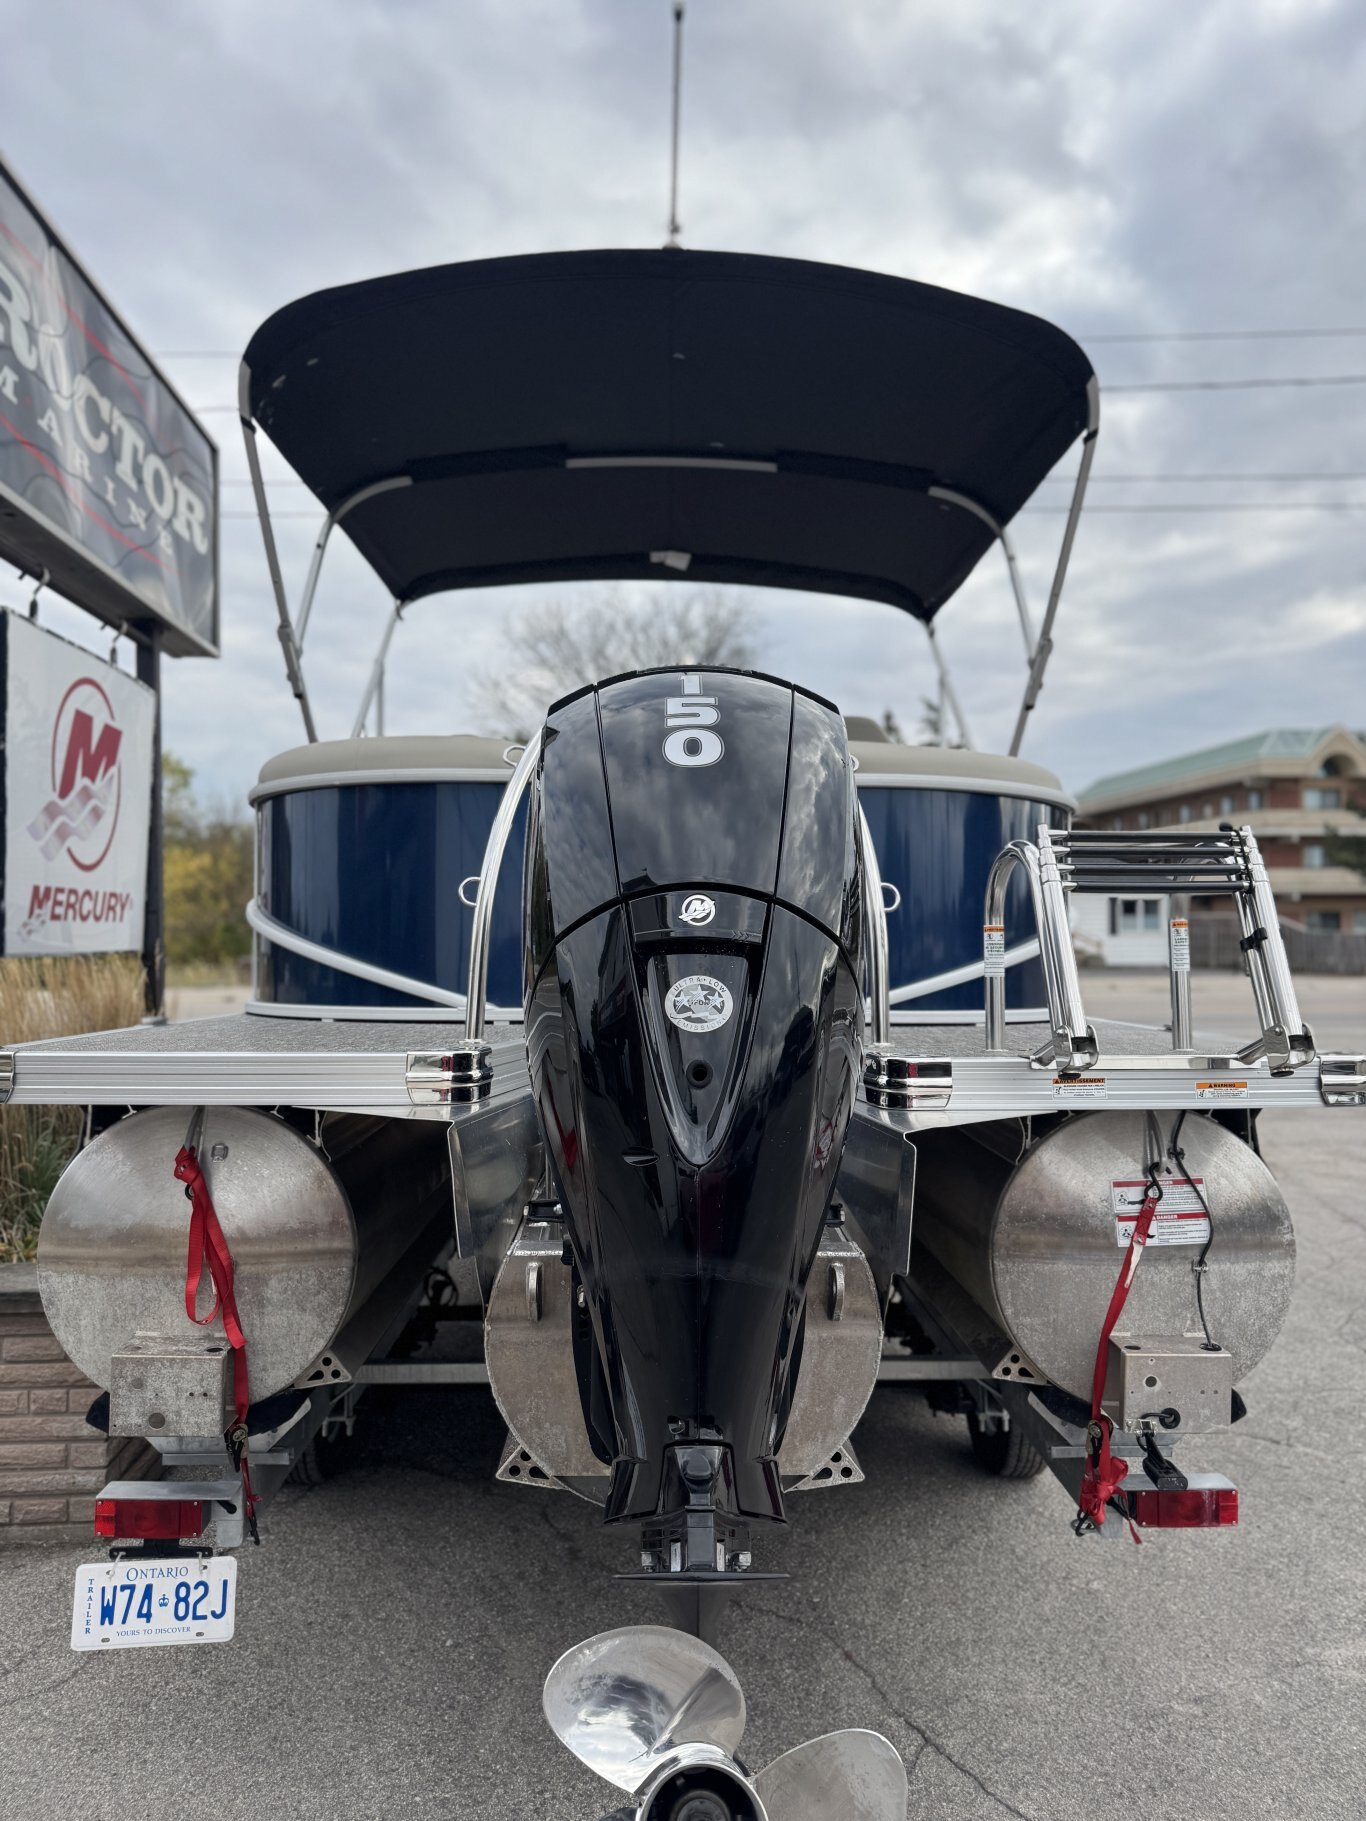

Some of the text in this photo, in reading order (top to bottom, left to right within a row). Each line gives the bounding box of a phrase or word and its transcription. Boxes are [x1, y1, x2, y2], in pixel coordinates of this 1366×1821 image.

[662, 674, 724, 767] 150
[28, 885, 130, 922] MERCURY
[126, 1566, 189, 1582] ONTARIO
[84, 1578, 95, 1635] TRAILER
[116, 1629, 140, 1637] YOURS
[155, 1626, 191, 1635] DISCOVER
